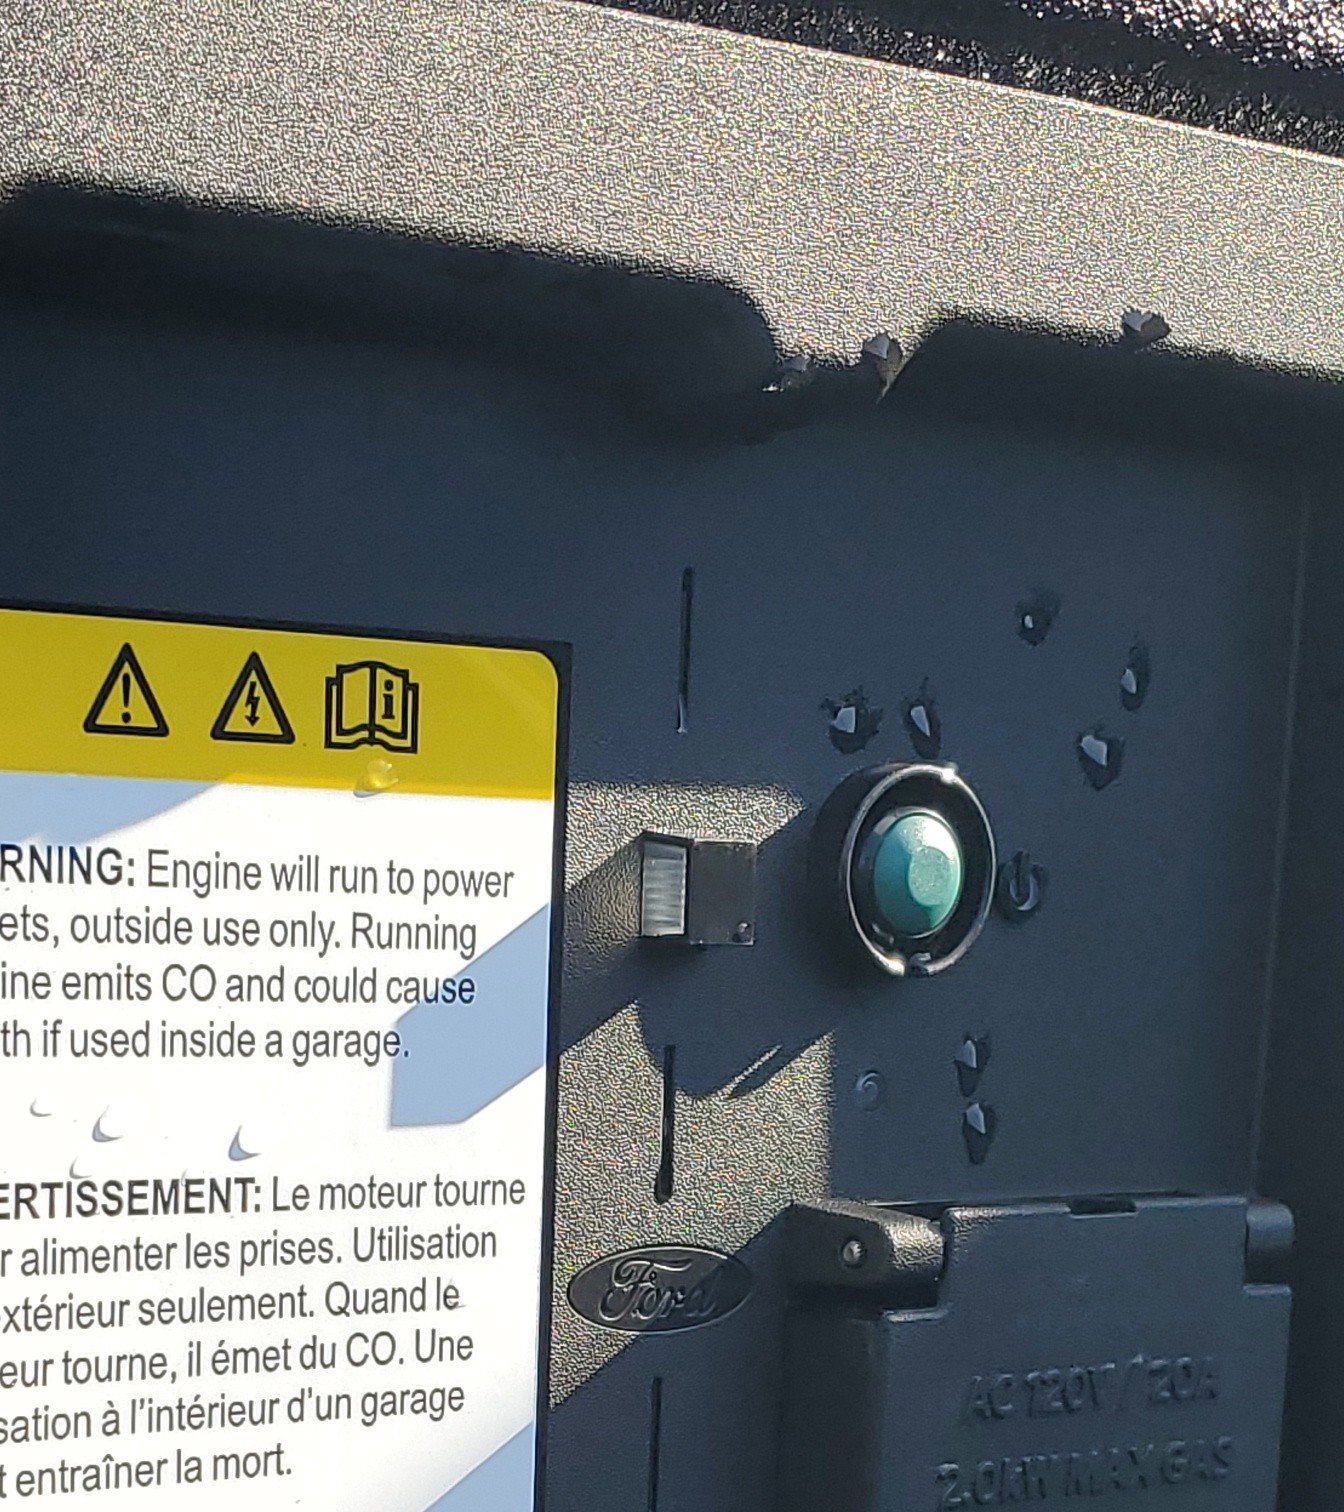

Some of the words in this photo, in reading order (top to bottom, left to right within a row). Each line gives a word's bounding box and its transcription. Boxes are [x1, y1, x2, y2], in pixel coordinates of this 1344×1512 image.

[148, 848, 262, 899] Engine
[270, 854, 320, 893] will
[329, 865, 378, 894] run
[386, 859, 415, 896] to
[423, 868, 515, 905] power
[70, 905, 193, 946] outside
[203, 917, 261, 947] use
[269, 910, 341, 959] only.
[351, 911, 476, 961] Running
[61, 962, 153, 1001] emits
[162, 963, 217, 1002] CO
[225, 964, 285, 1003] and
[294, 966, 377, 1004] could
[386, 976, 476, 1005] cause
[42, 1018, 63, 1058] if
[70, 1020, 150, 1058] used
[161, 1020, 256, 1058] inside
[265, 1030, 283, 1058] a
[292, 1030, 409, 1068] garage.
[272, 1175, 310, 1212] Le
[319, 1175, 428, 1211] moteur
[433, 1173, 526, 1207] tourne
[20, 1236, 178, 1277] alimenter
[185, 1232, 230, 1269] les
[240, 1229, 342, 1277] prises.
[353, 1223, 497, 1263] Utilisation
[138, 1284, 314, 1326] seulement.
[324, 1276, 427, 1318] Quand
[436, 1276, 460, 1311] le
[598, 1256, 720, 1321] Ford
[61, 1350, 177, 1385] tourne,
[188, 1340, 201, 1377] il
[211, 1338, 292, 1376] émet
[299, 1334, 337, 1371] du
[346, 1330, 404, 1368] CO.
[415, 1328, 474, 1364] Une
[101, 1400, 121, 1437] à
[361, 1386, 465, 1427] garage
[15, 1453, 169, 1497] entraîner
[176, 1448, 203, 1484] la
[213, 1442, 292, 1481] mort.
